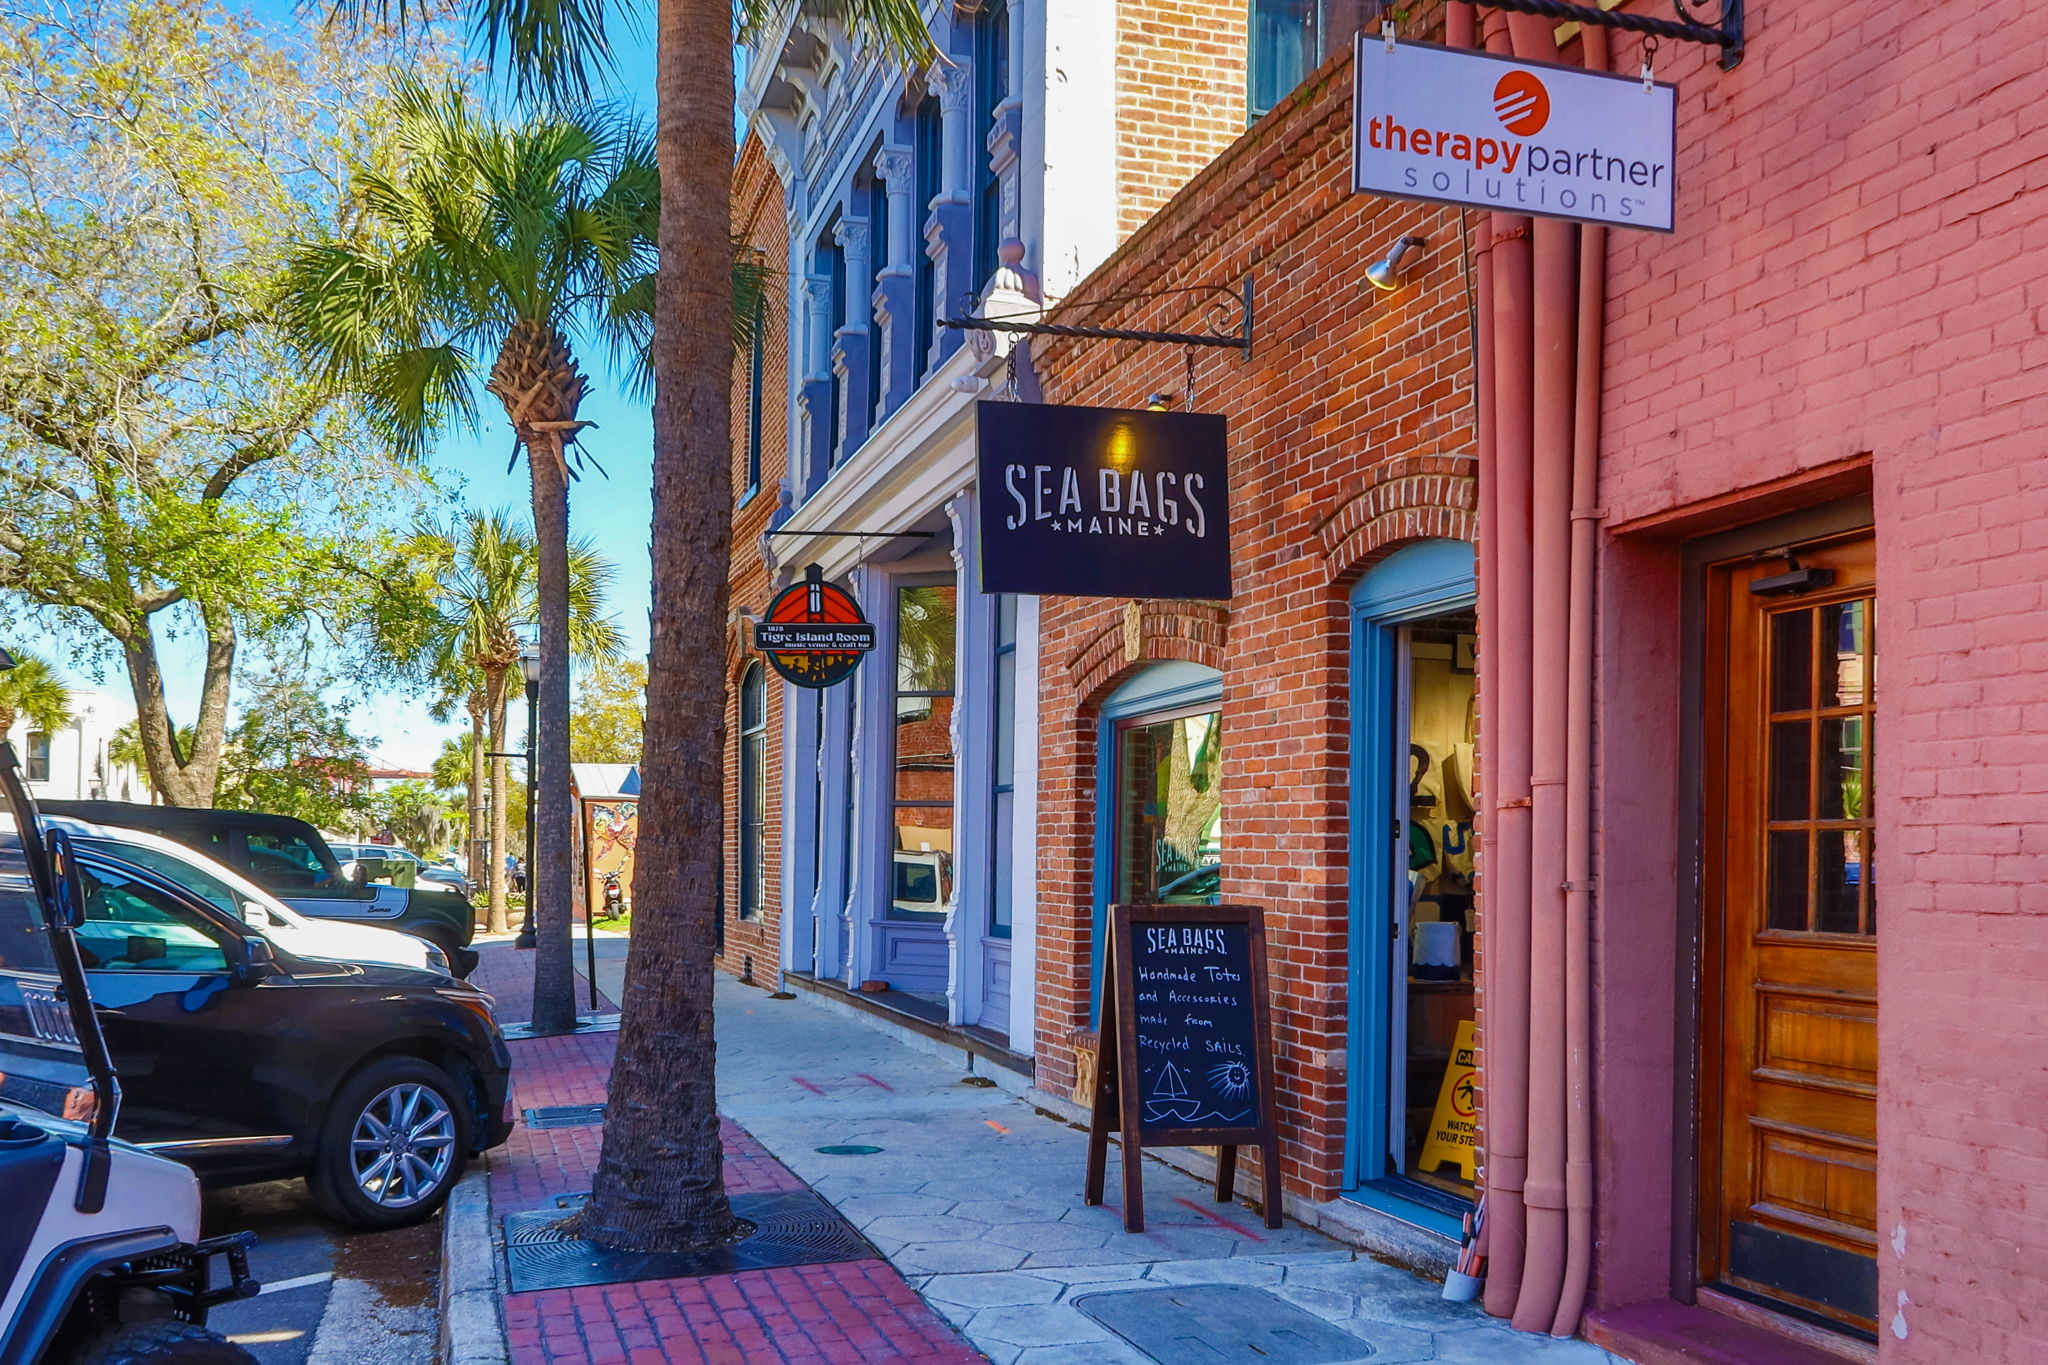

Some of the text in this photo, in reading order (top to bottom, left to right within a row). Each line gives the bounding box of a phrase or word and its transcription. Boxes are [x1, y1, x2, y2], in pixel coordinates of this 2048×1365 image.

[1404, 167, 1633, 217] solutions
[1005, 464, 1205, 538] SEA BAGS
[1067, 516, 1149, 536] MAINE
[760, 632, 870, 643] Tigre Island Room
[1147, 928, 1225, 954] SEA BAGS
[1139, 966, 1240, 983] Handmade Totes
[1139, 989, 1158, 1002] and
[1139, 1035, 1190, 1054] Recycled
[1447, 1120, 1475, 1133] WATCH
[1436, 1130, 1475, 1146] YOUR STE
